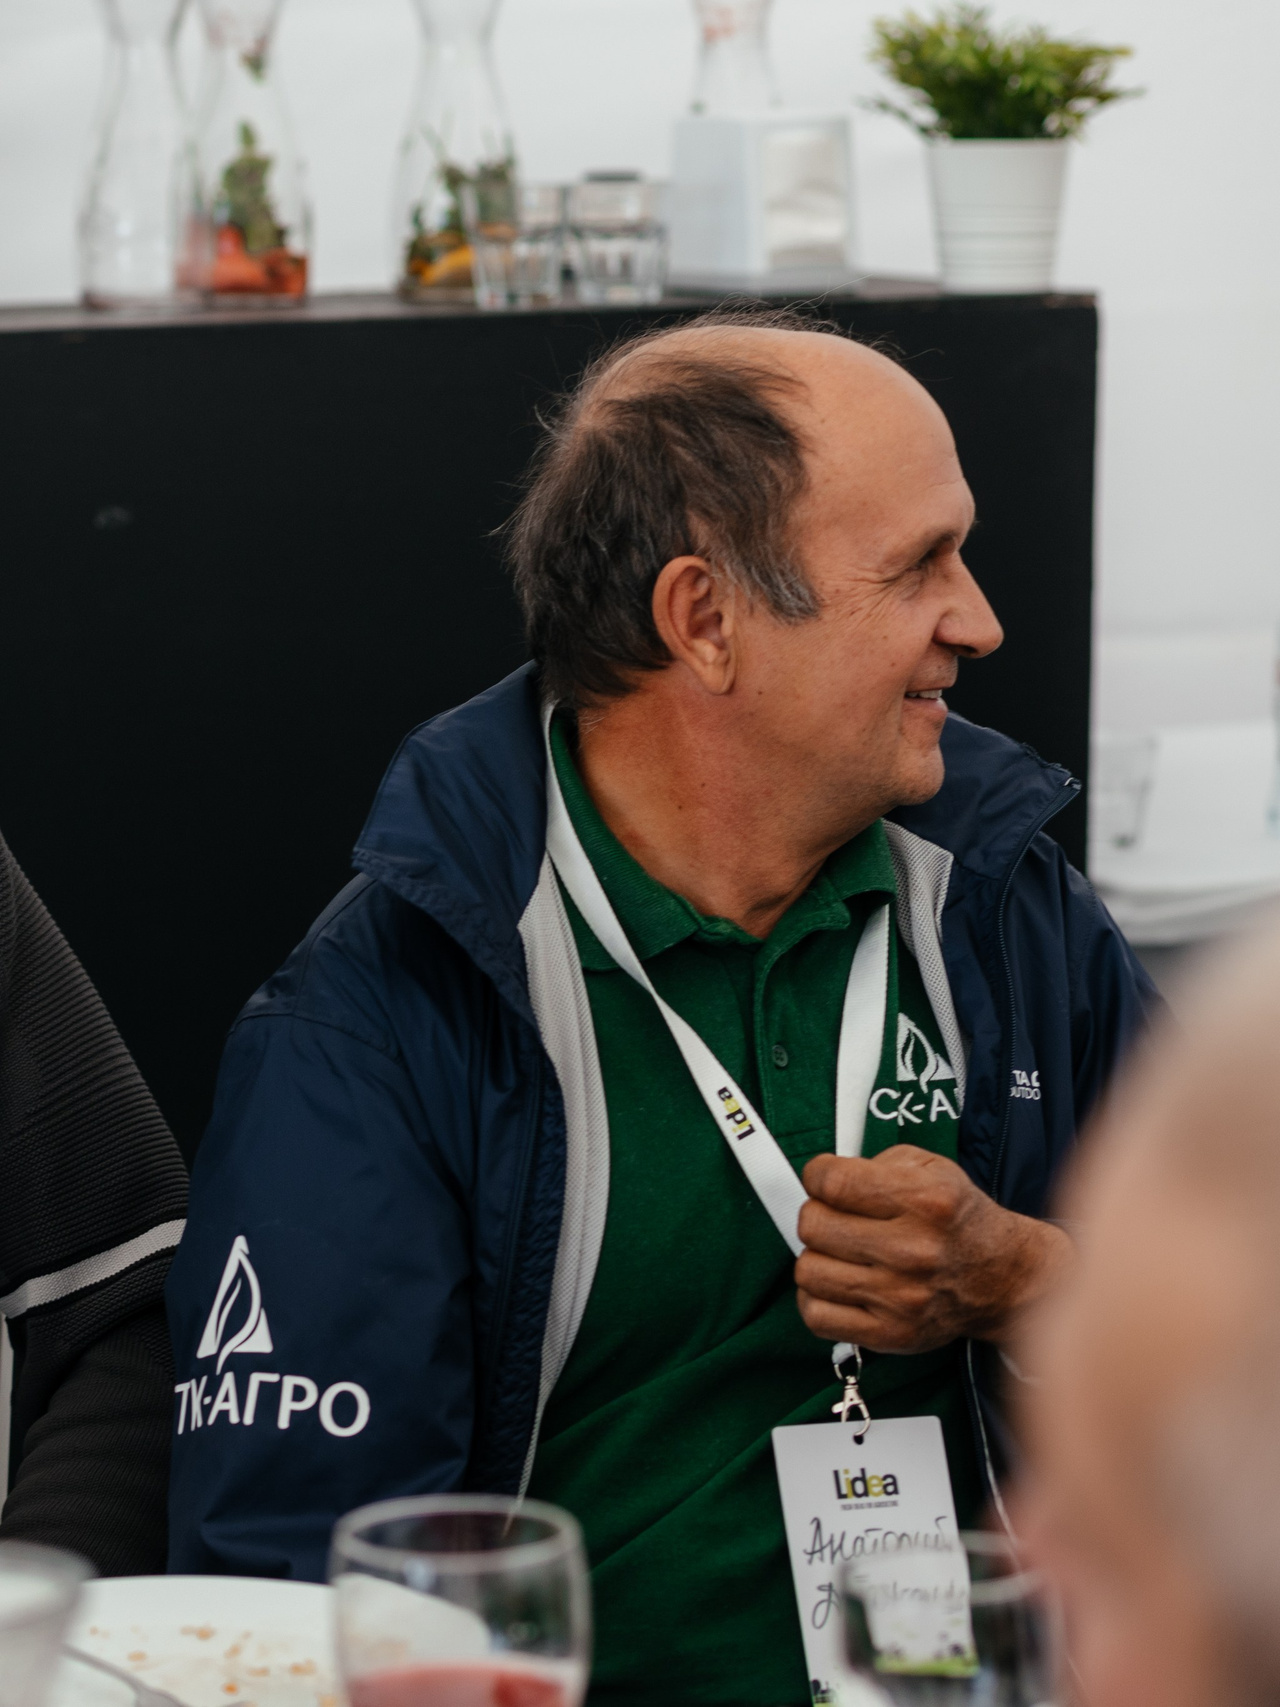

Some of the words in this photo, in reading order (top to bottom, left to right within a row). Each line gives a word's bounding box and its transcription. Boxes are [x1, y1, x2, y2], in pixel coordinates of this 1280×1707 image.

[869, 1087, 962, 1127] СК-А
[174, 1371, 372, 1438] ТК-АГРО
[832, 1467, 900, 1500] Lidea
